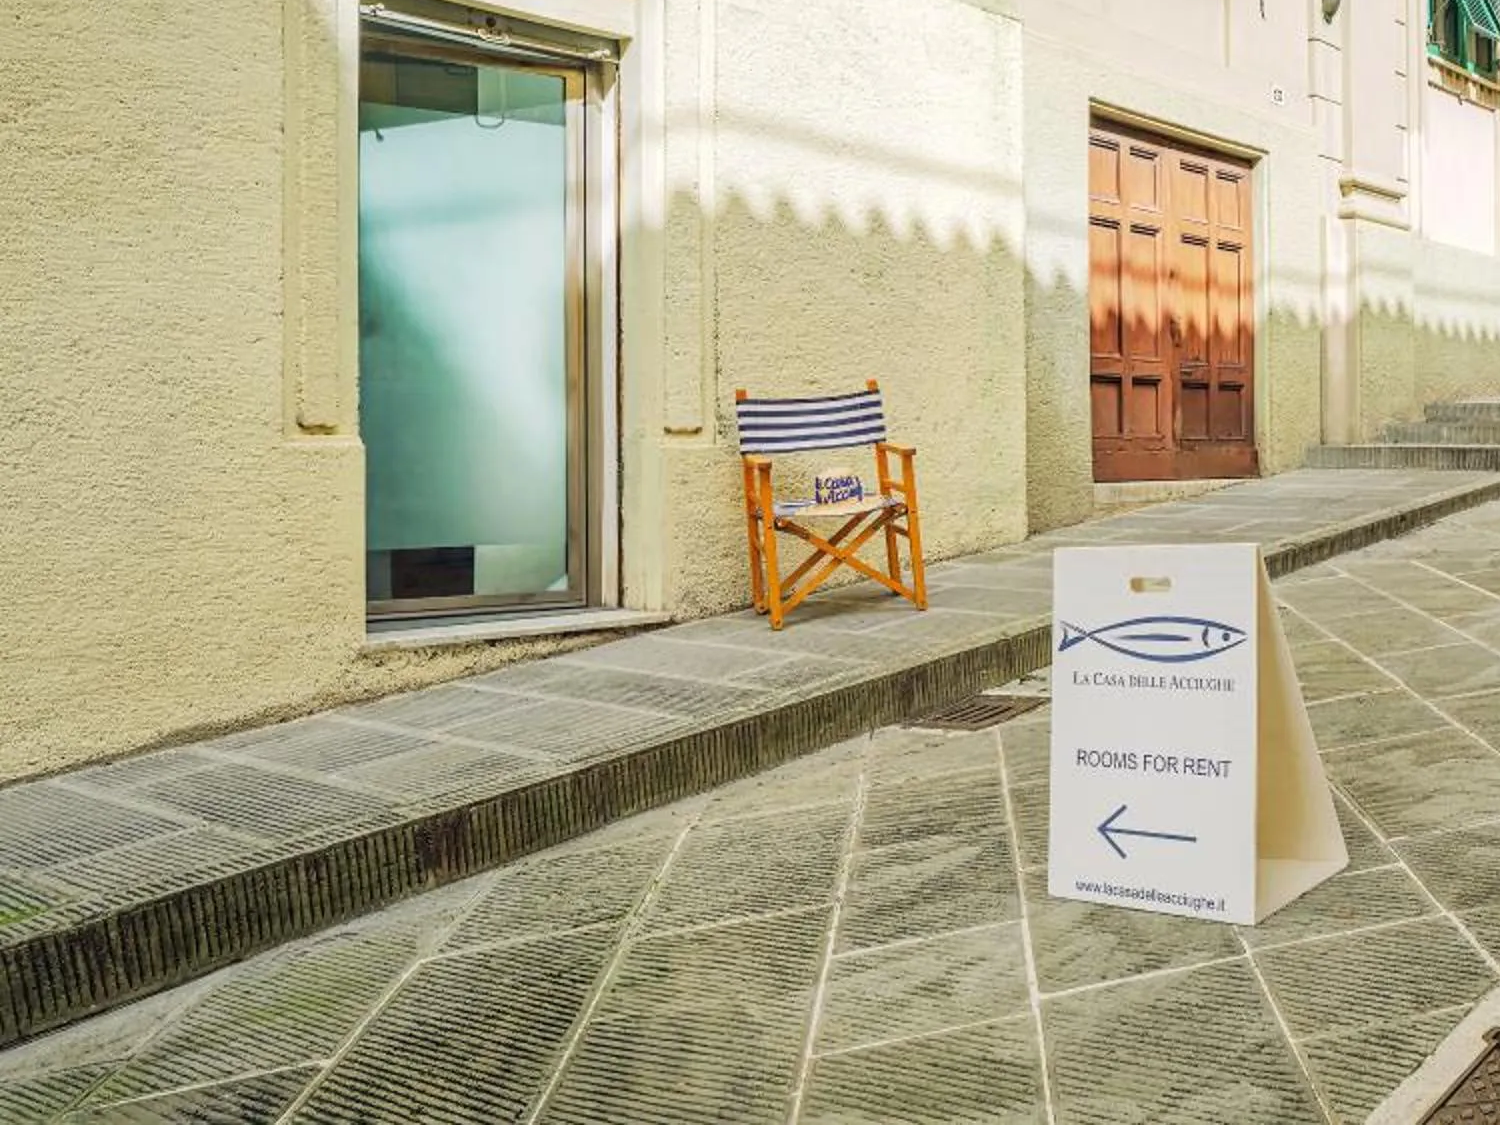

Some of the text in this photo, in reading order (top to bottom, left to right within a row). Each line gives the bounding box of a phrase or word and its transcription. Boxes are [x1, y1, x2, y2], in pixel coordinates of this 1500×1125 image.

[1093, 672, 1126, 688] CASA
[1076, 748, 1232, 779] ROOMS FOR RENT
